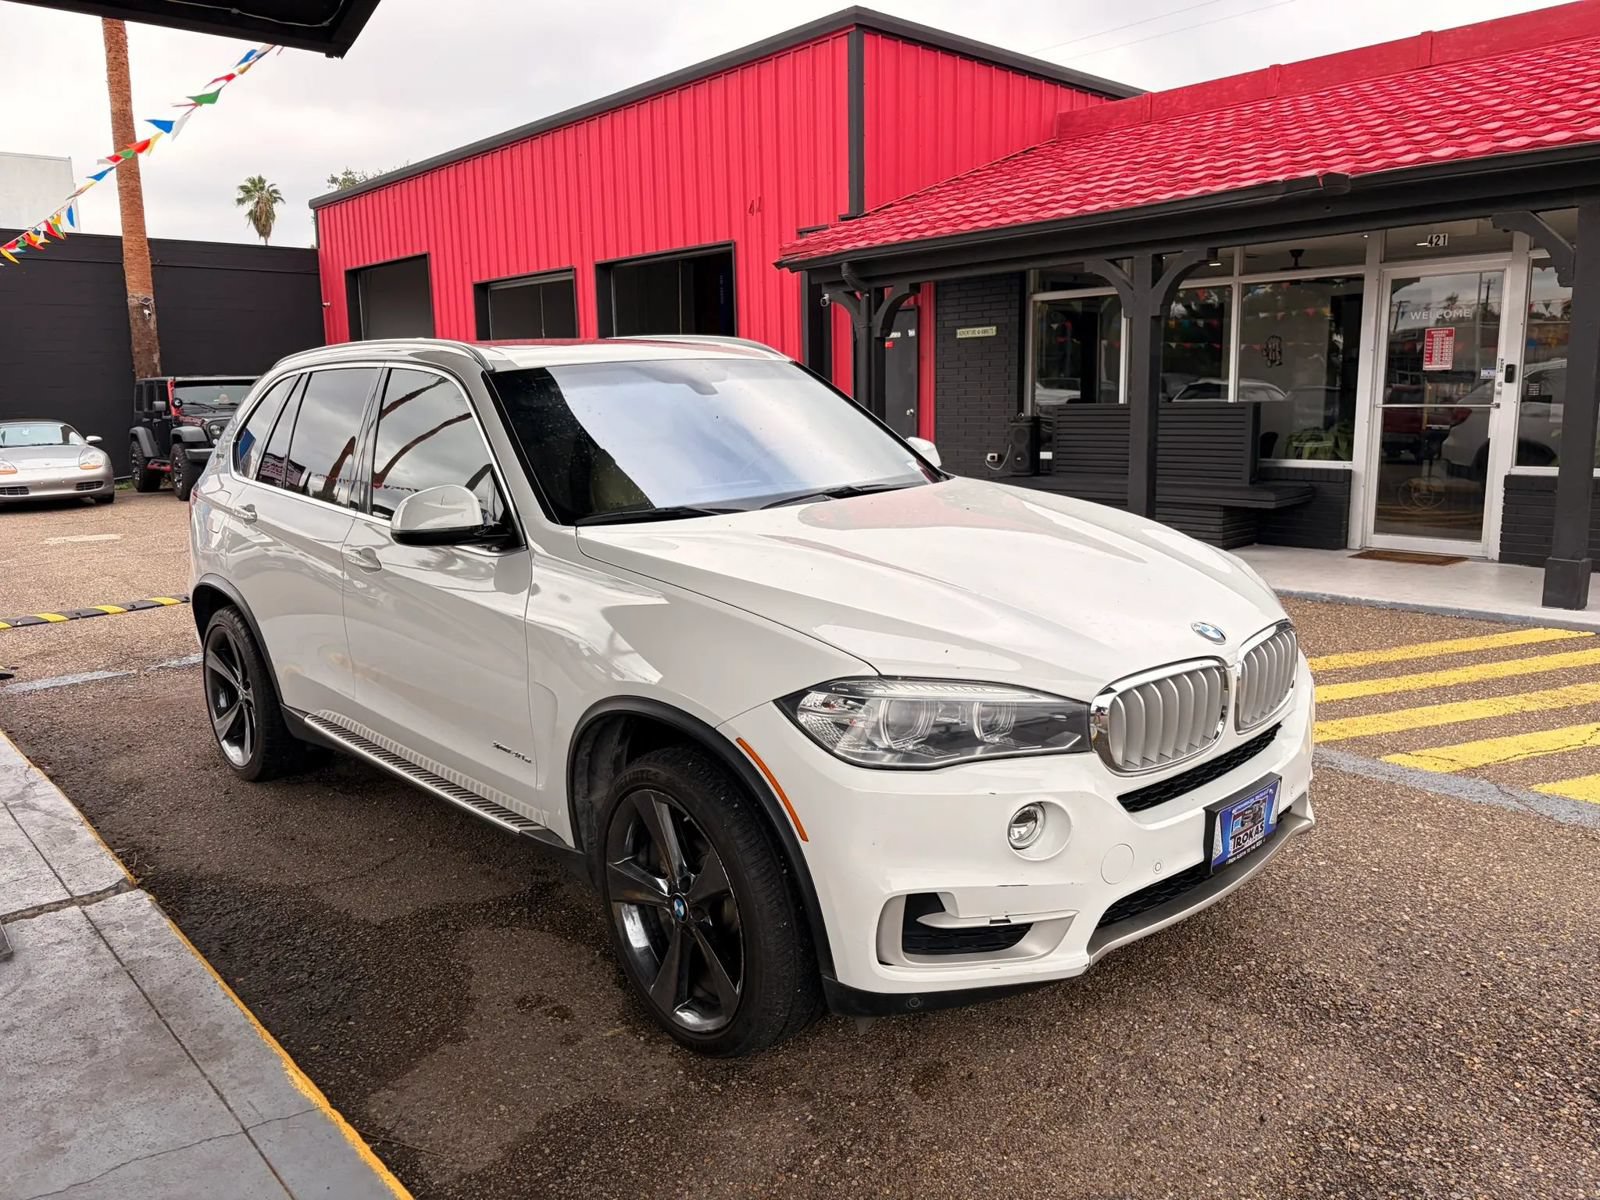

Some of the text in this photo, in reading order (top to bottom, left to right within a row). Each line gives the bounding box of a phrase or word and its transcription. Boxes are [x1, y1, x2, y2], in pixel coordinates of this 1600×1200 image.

[1428, 234, 1447, 247] 421
[1410, 309, 1472, 320] WELCOME
[1230, 822, 1265, 850] TROKAS
